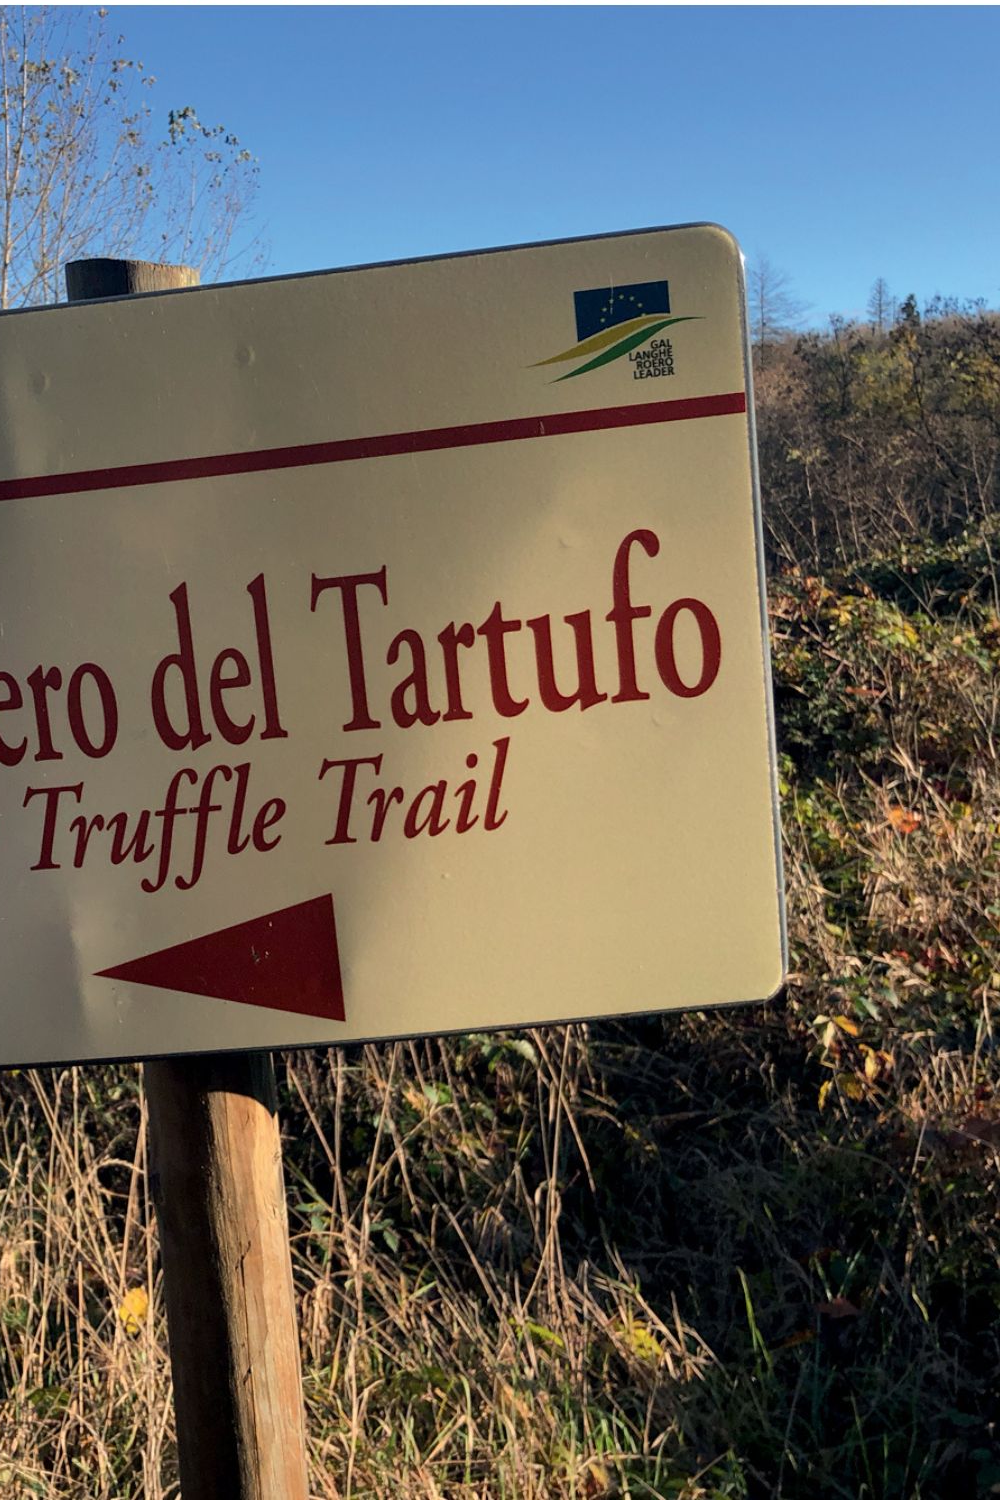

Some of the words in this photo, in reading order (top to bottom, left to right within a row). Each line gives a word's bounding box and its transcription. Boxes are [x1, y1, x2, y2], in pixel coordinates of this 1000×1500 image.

[650, 338, 673, 349] GAL
[629, 347, 673, 361] LANGHE
[636, 357, 674, 370] ROERO
[633, 366, 675, 380] LEADER
[150, 571, 289, 752] del
[309, 528, 723, 732] Tartufo
[22, 762, 287, 893] Truffle
[317, 736, 513, 847] Trail
